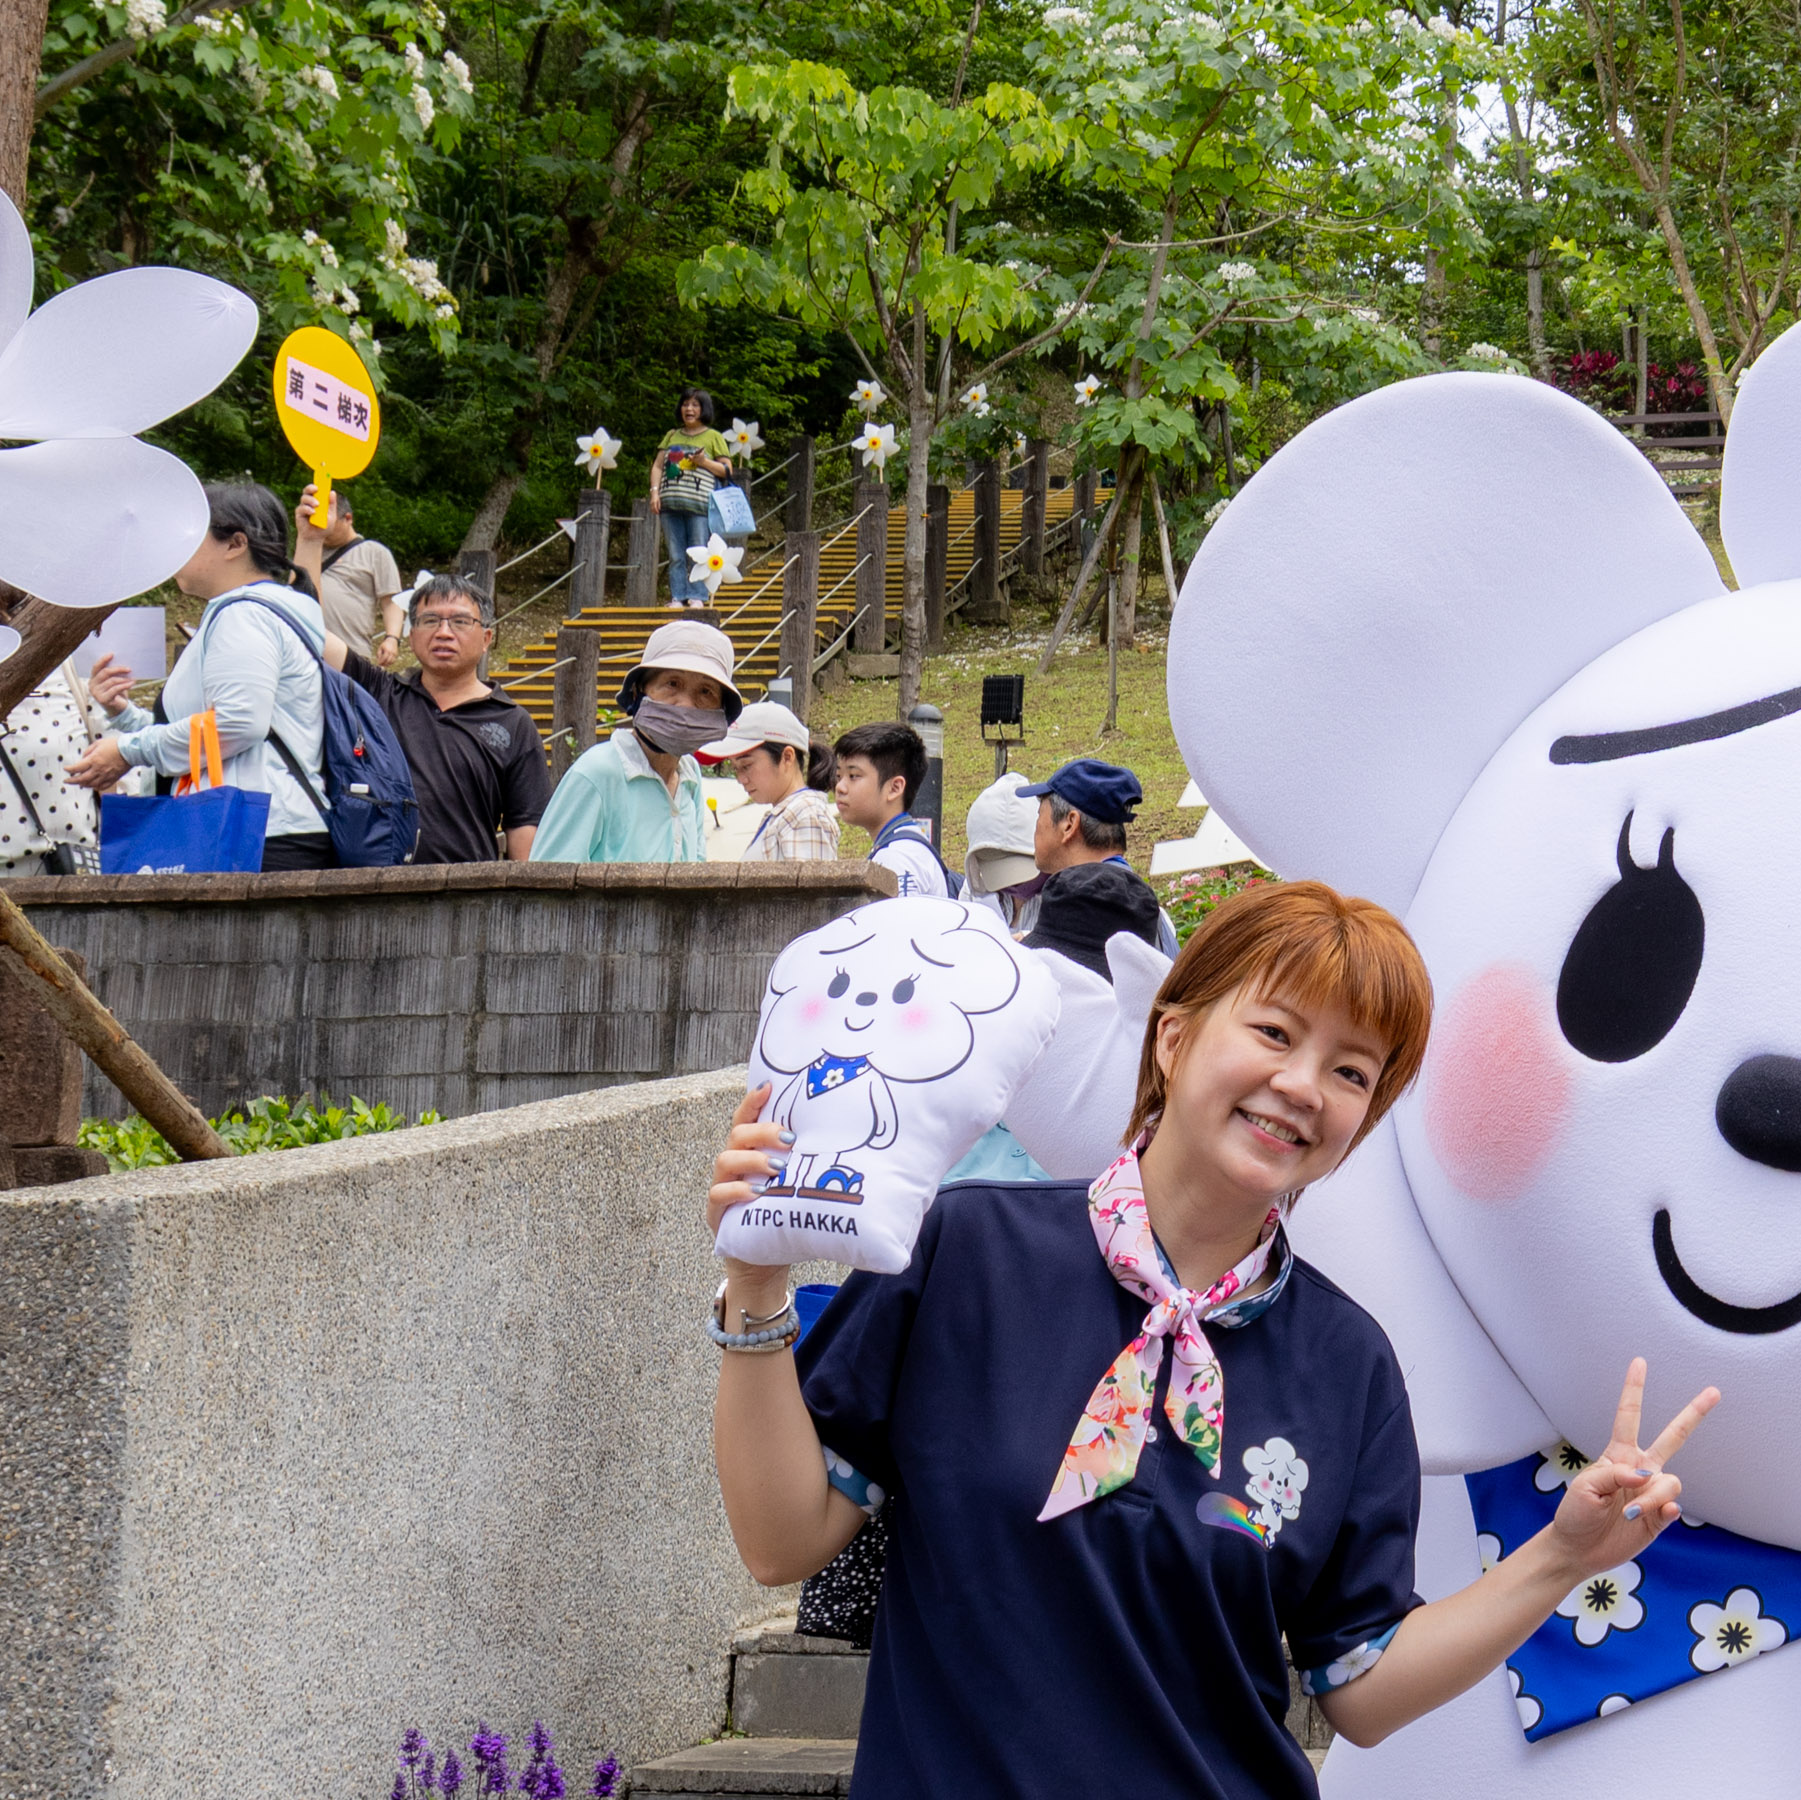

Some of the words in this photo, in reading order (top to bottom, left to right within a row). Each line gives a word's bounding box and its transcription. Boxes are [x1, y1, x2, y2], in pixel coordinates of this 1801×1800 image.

[289, 367, 368, 432] 第二梯次
[741, 1208, 784, 1228] NTPC
[790, 1210, 859, 1237] HAKKA
